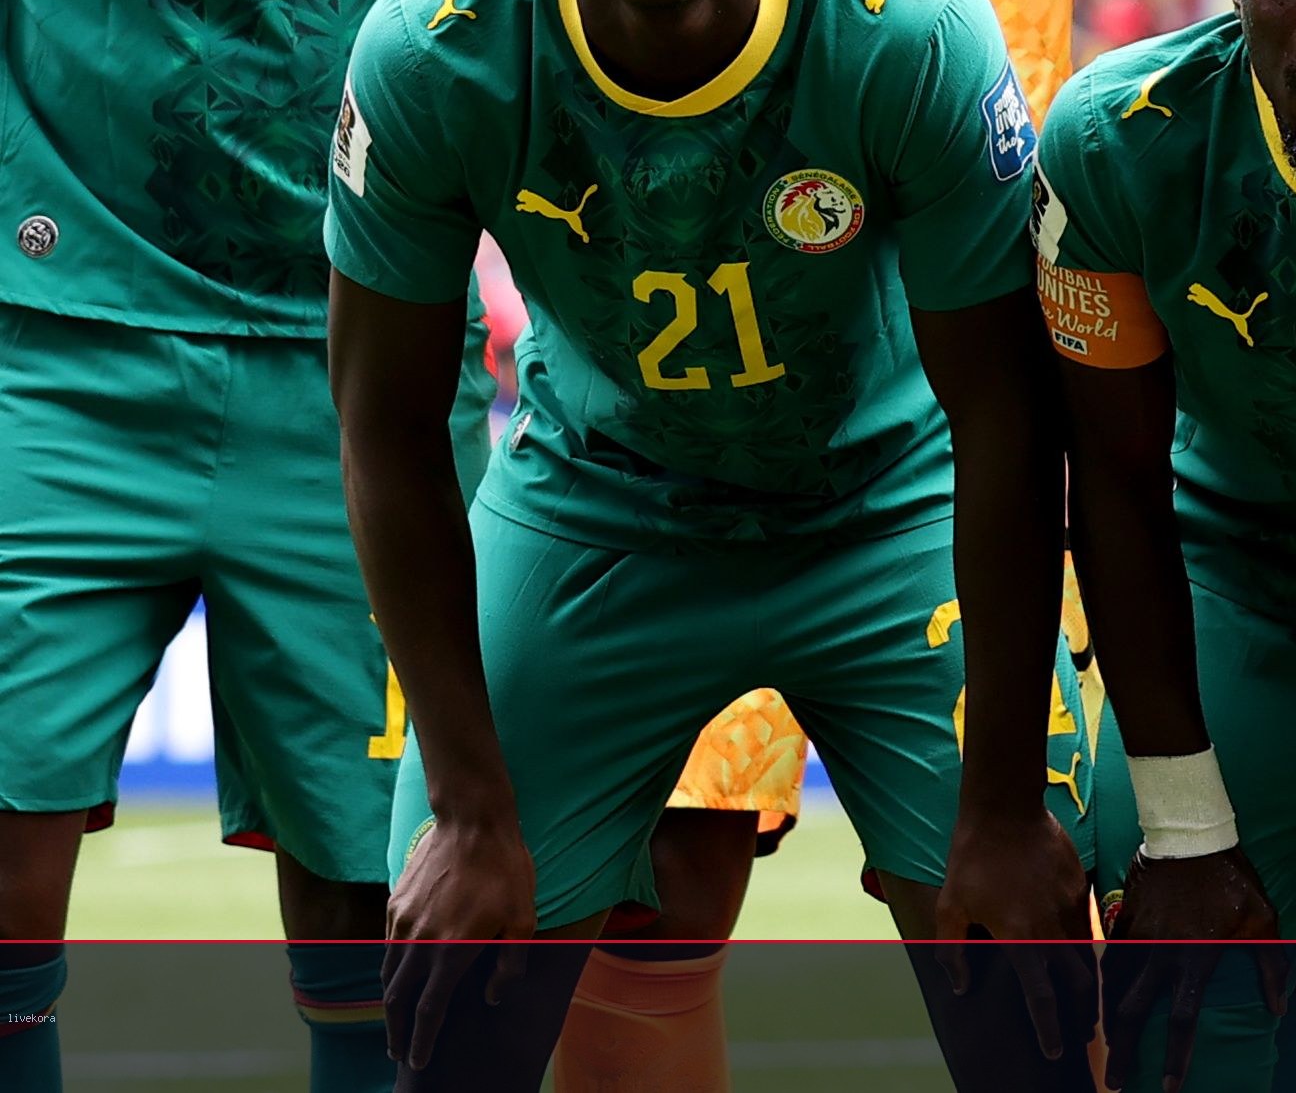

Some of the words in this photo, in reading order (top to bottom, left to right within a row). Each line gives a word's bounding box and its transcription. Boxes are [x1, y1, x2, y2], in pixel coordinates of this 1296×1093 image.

[1038, 264, 1111, 317] UNITES
[632, 261, 787, 391] 21
[1054, 331, 1086, 352] FIFA
[1057, 307, 1119, 341] World
